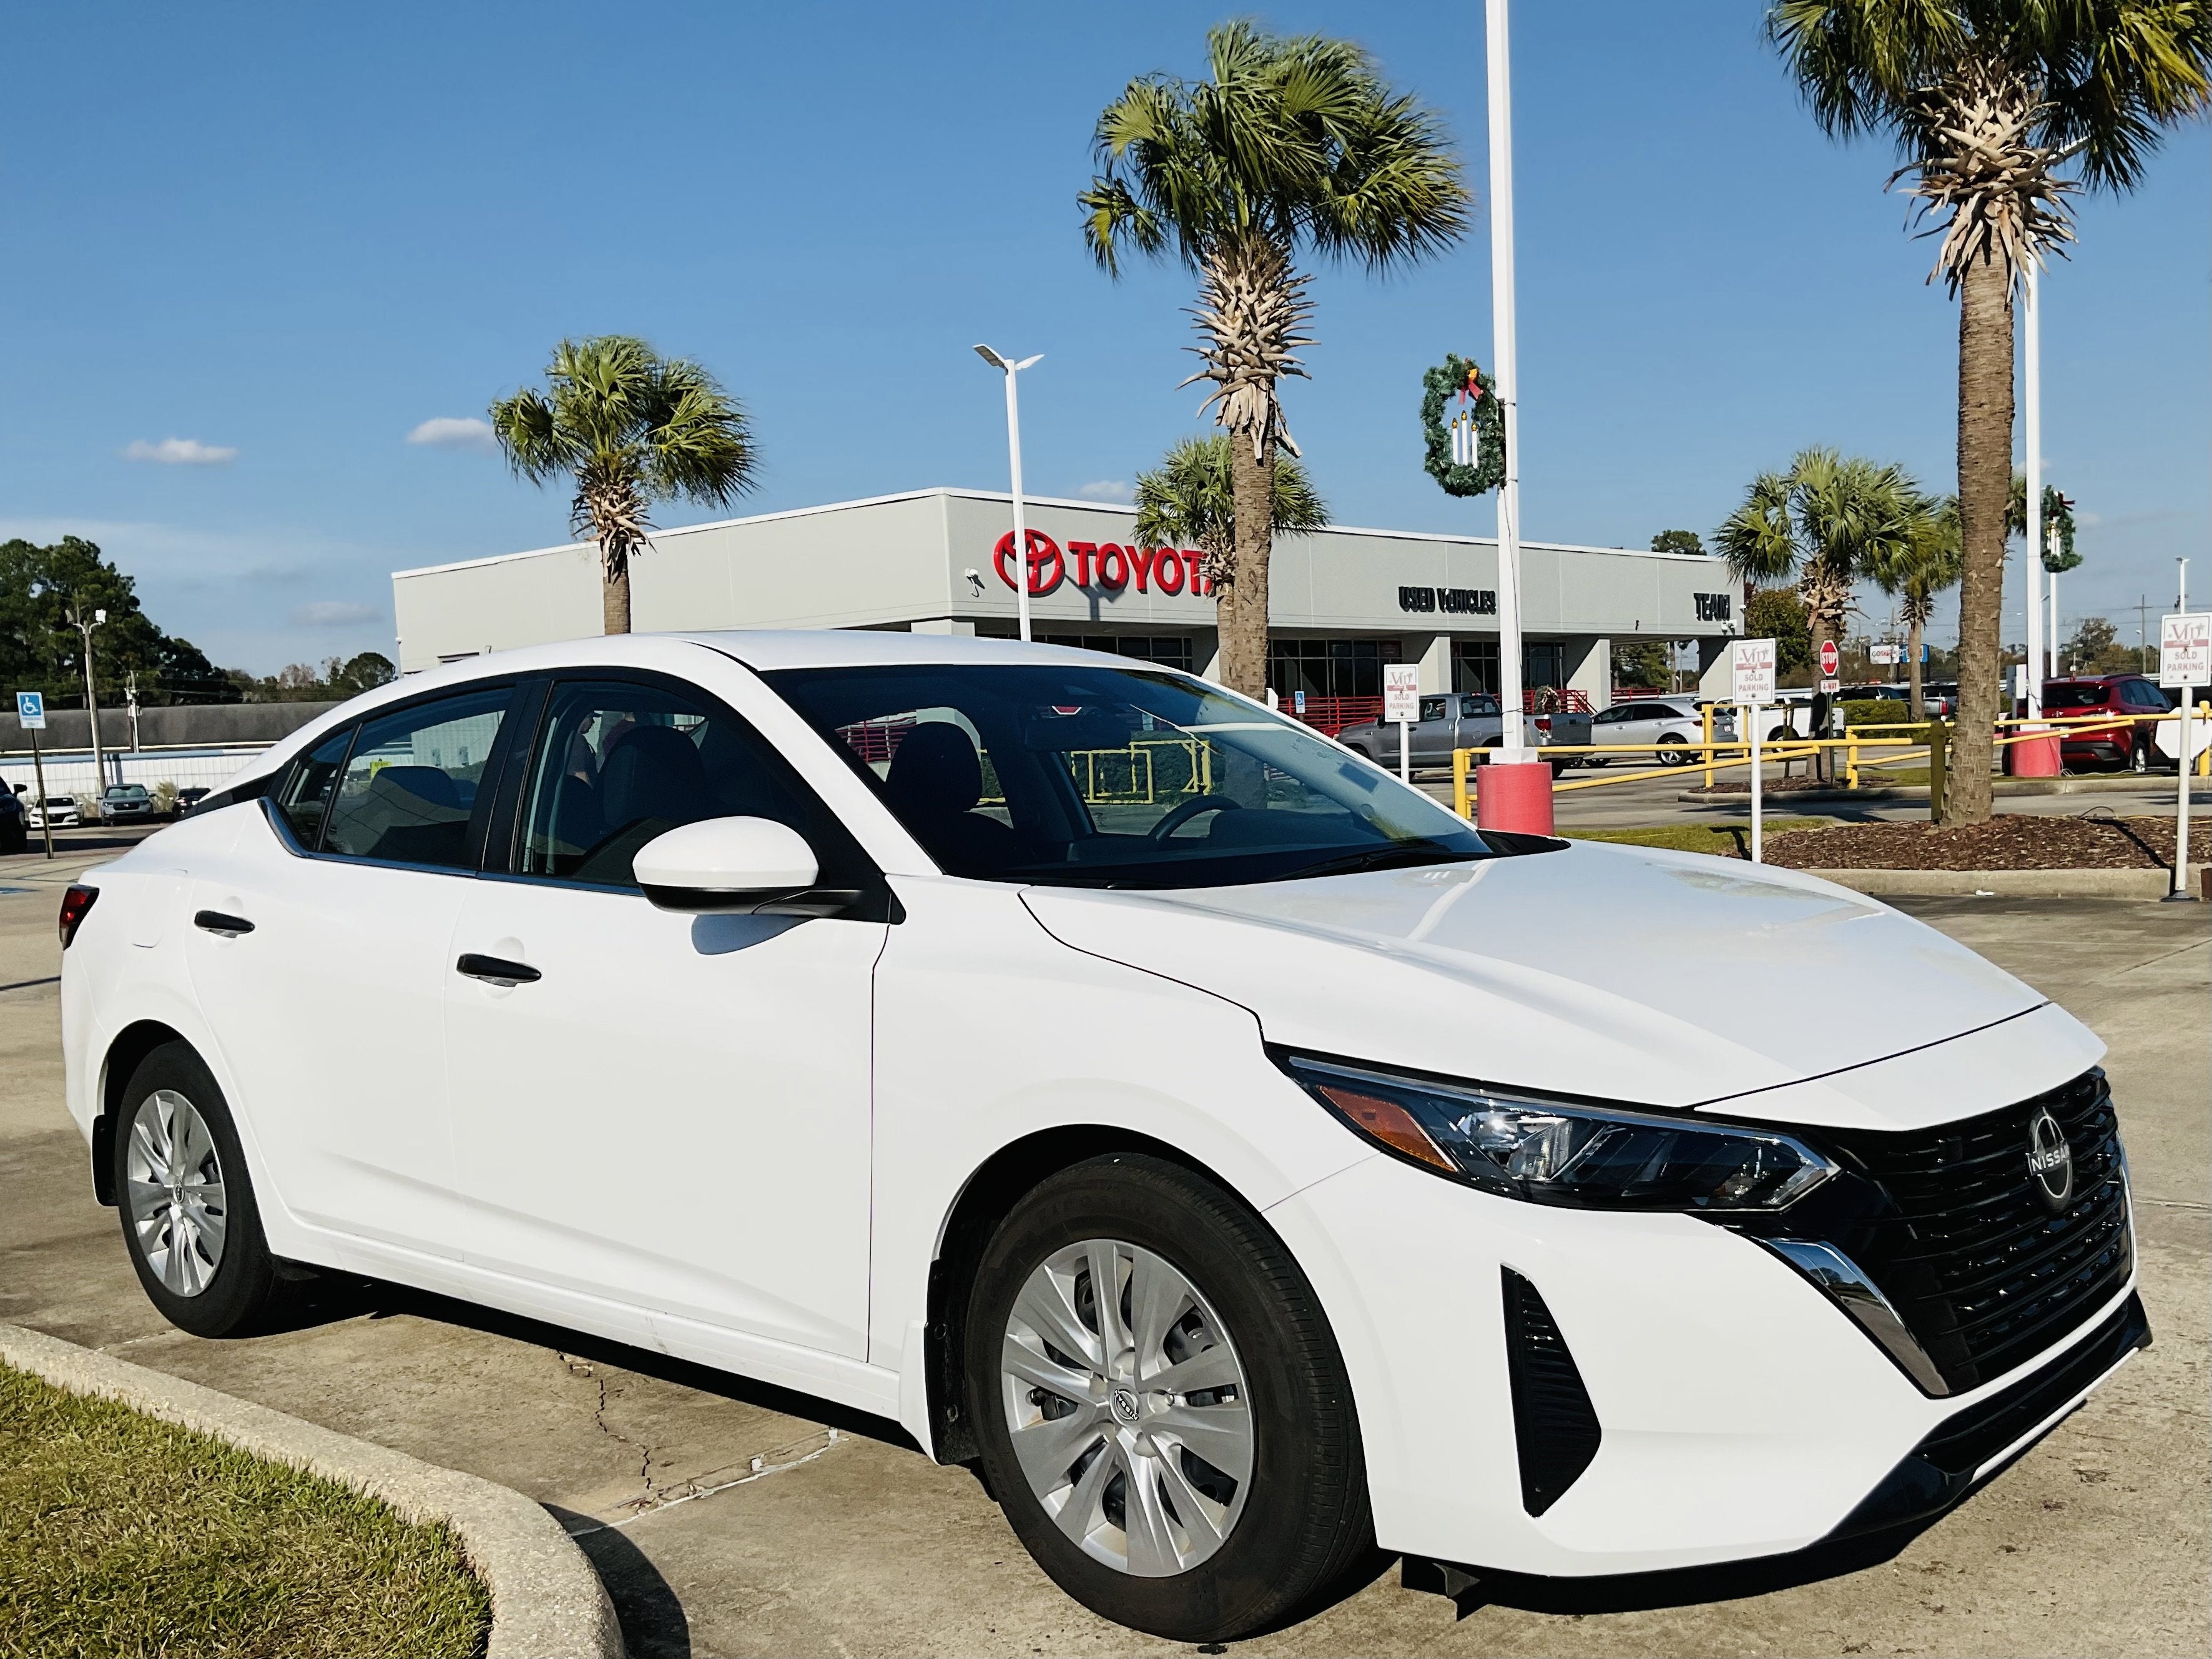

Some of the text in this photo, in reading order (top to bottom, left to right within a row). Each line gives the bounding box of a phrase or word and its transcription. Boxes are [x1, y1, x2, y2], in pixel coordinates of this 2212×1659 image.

[1068, 541, 1214, 597] TOYOT
[1398, 586, 1496, 614] USED VEHICLES
[1821, 652, 1836, 664] STOP
[2175, 651, 2197, 660] SOLD
[2166, 662, 2204, 672] PARKING
[1744, 674, 1763, 682] SOLD
[1738, 684, 1769, 692] PARKING
